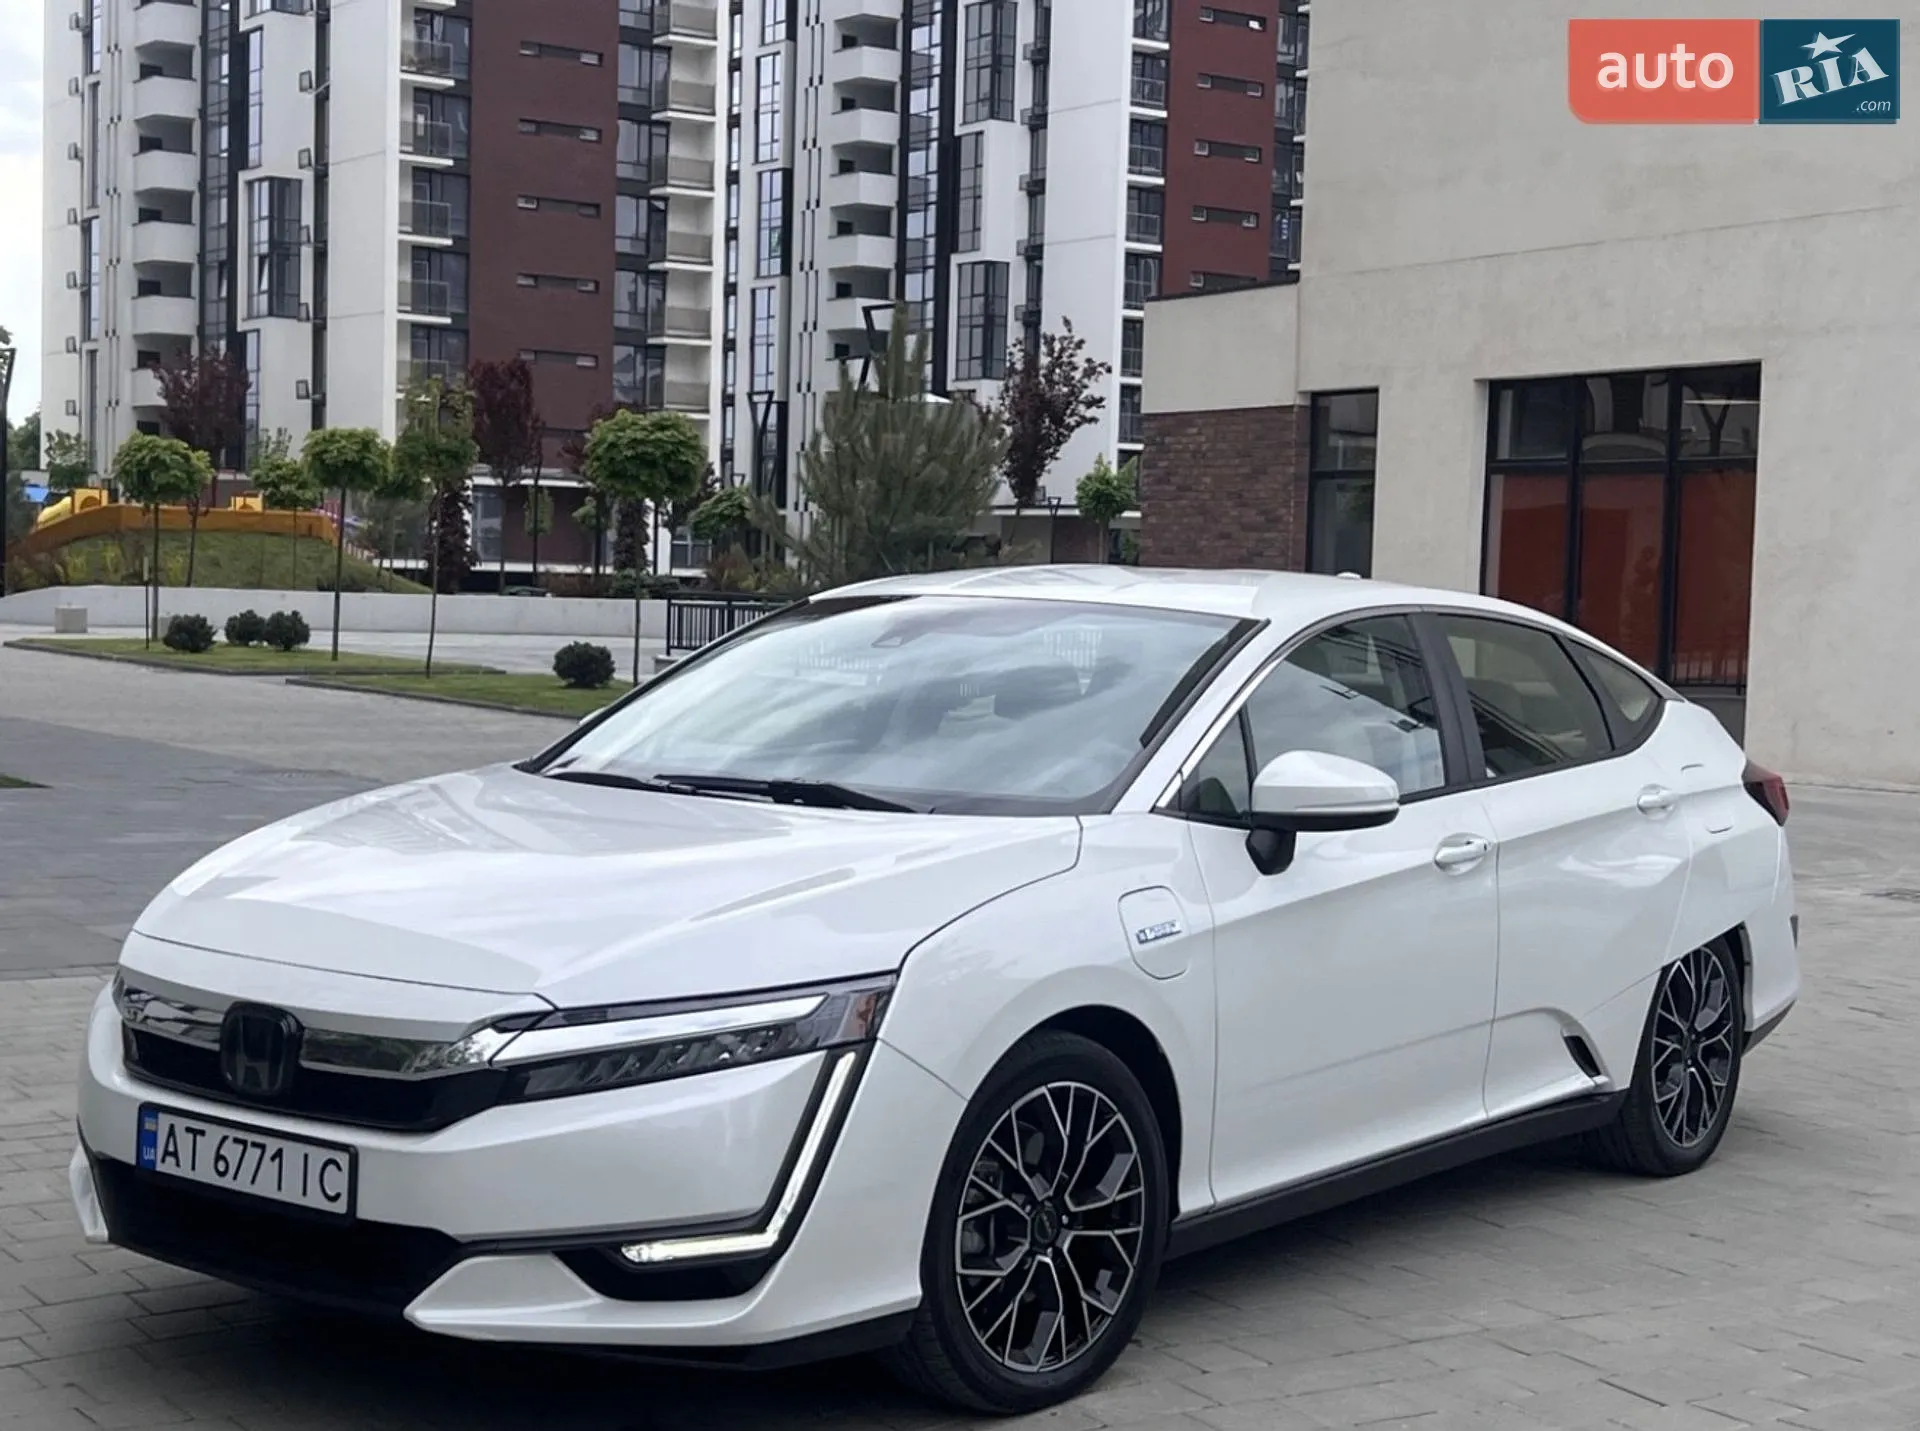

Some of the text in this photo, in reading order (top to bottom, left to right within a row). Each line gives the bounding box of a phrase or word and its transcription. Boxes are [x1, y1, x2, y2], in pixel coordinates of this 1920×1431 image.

[143, 1146, 156, 1160] UA
[160, 1122, 343, 1203] AT 6771 IC
